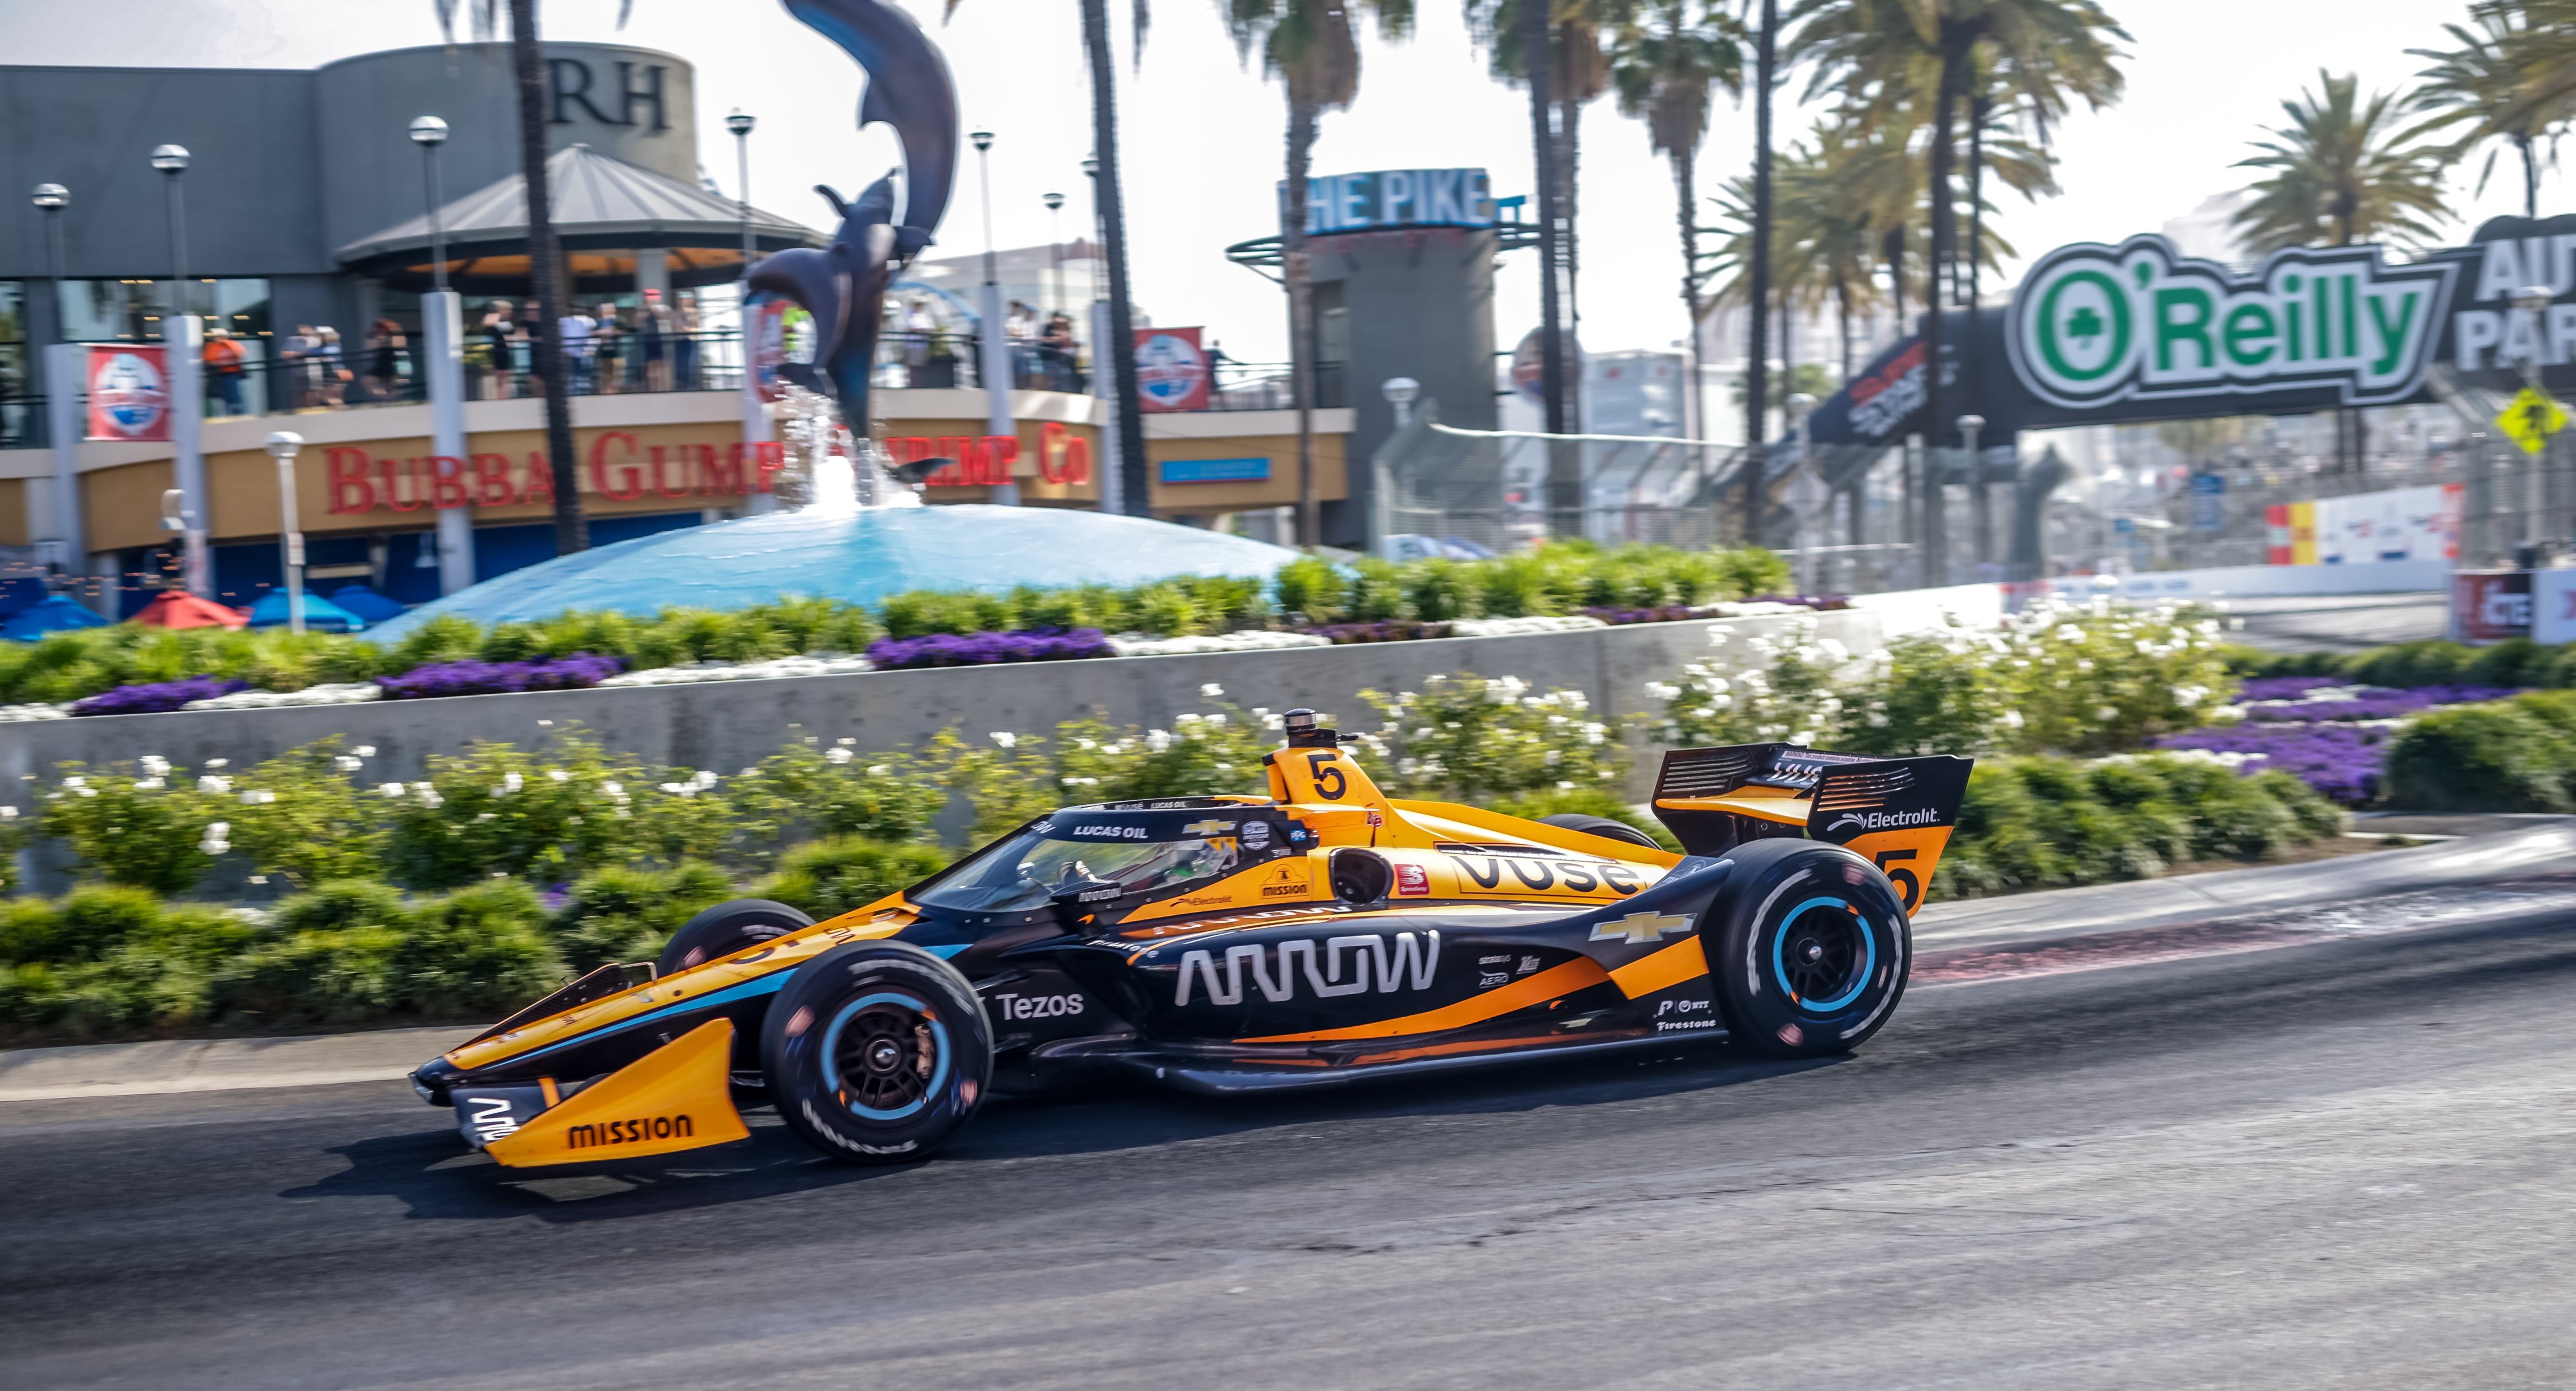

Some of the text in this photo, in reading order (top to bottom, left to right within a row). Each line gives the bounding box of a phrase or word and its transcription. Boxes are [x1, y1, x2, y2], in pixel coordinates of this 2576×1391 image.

[548, 58, 675, 131] RH
[1281, 169, 1493, 235] HE PIKE
[2474, 234, 2576, 302] AU
[2038, 260, 2421, 382] O'Reilly
[1307, 753, 1346, 800] 5
[1073, 826, 1148, 839] LUCAS OIL
[1867, 808, 1938, 828] Electrolit
[1872, 849, 1919, 912] 5
[1174, 930, 1440, 1007] ARROW
[995, 993, 1085, 1021] Tezos
[1656, 1019, 1716, 1032] Firestone
